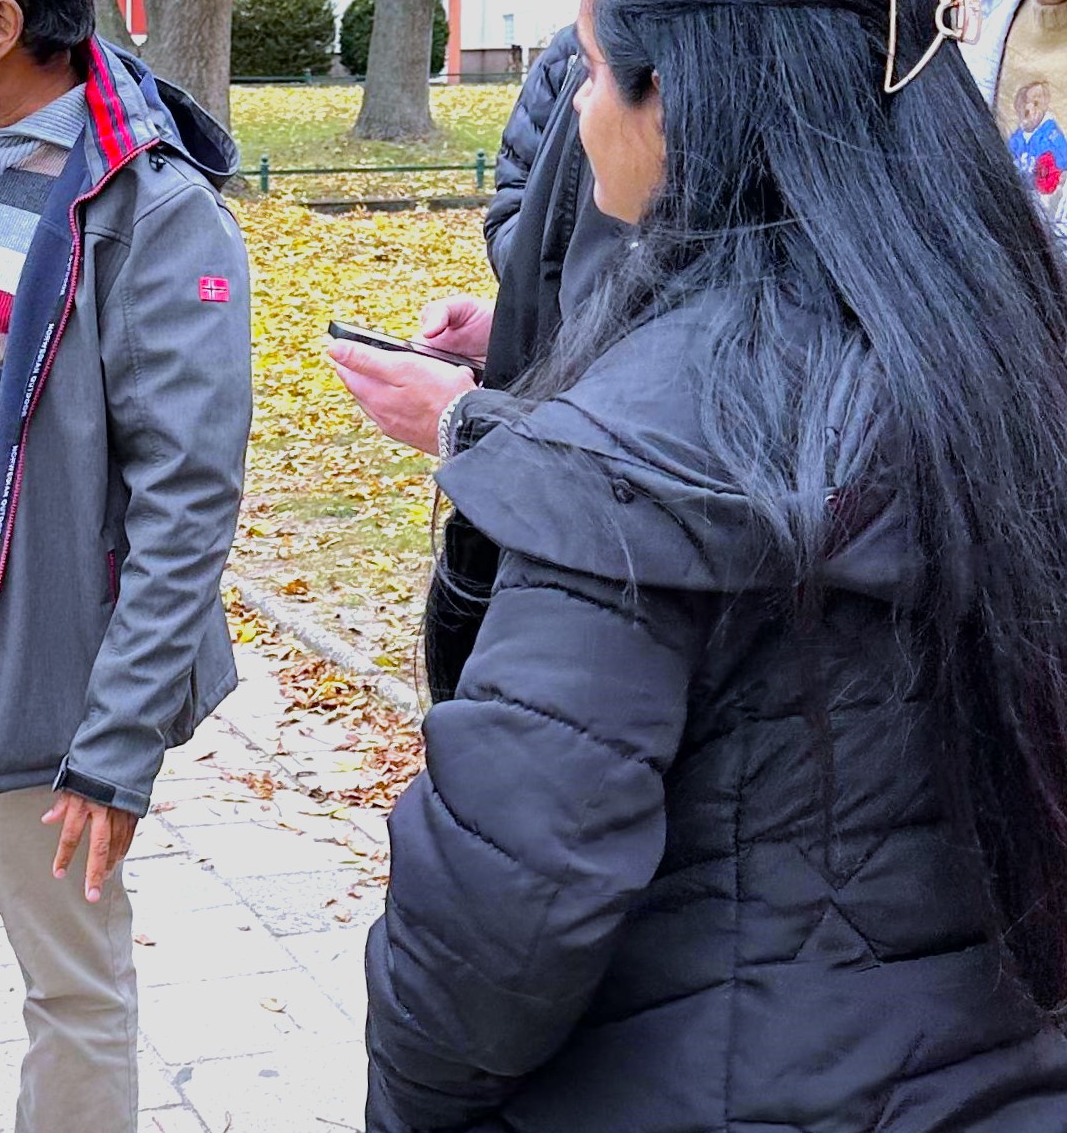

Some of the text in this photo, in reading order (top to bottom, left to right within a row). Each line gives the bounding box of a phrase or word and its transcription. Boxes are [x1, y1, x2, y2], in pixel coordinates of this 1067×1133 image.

[21, 323, 55, 419] NORWEGIAN OUTDOOR
[2, 444, 19, 498] NORWEGIAN
